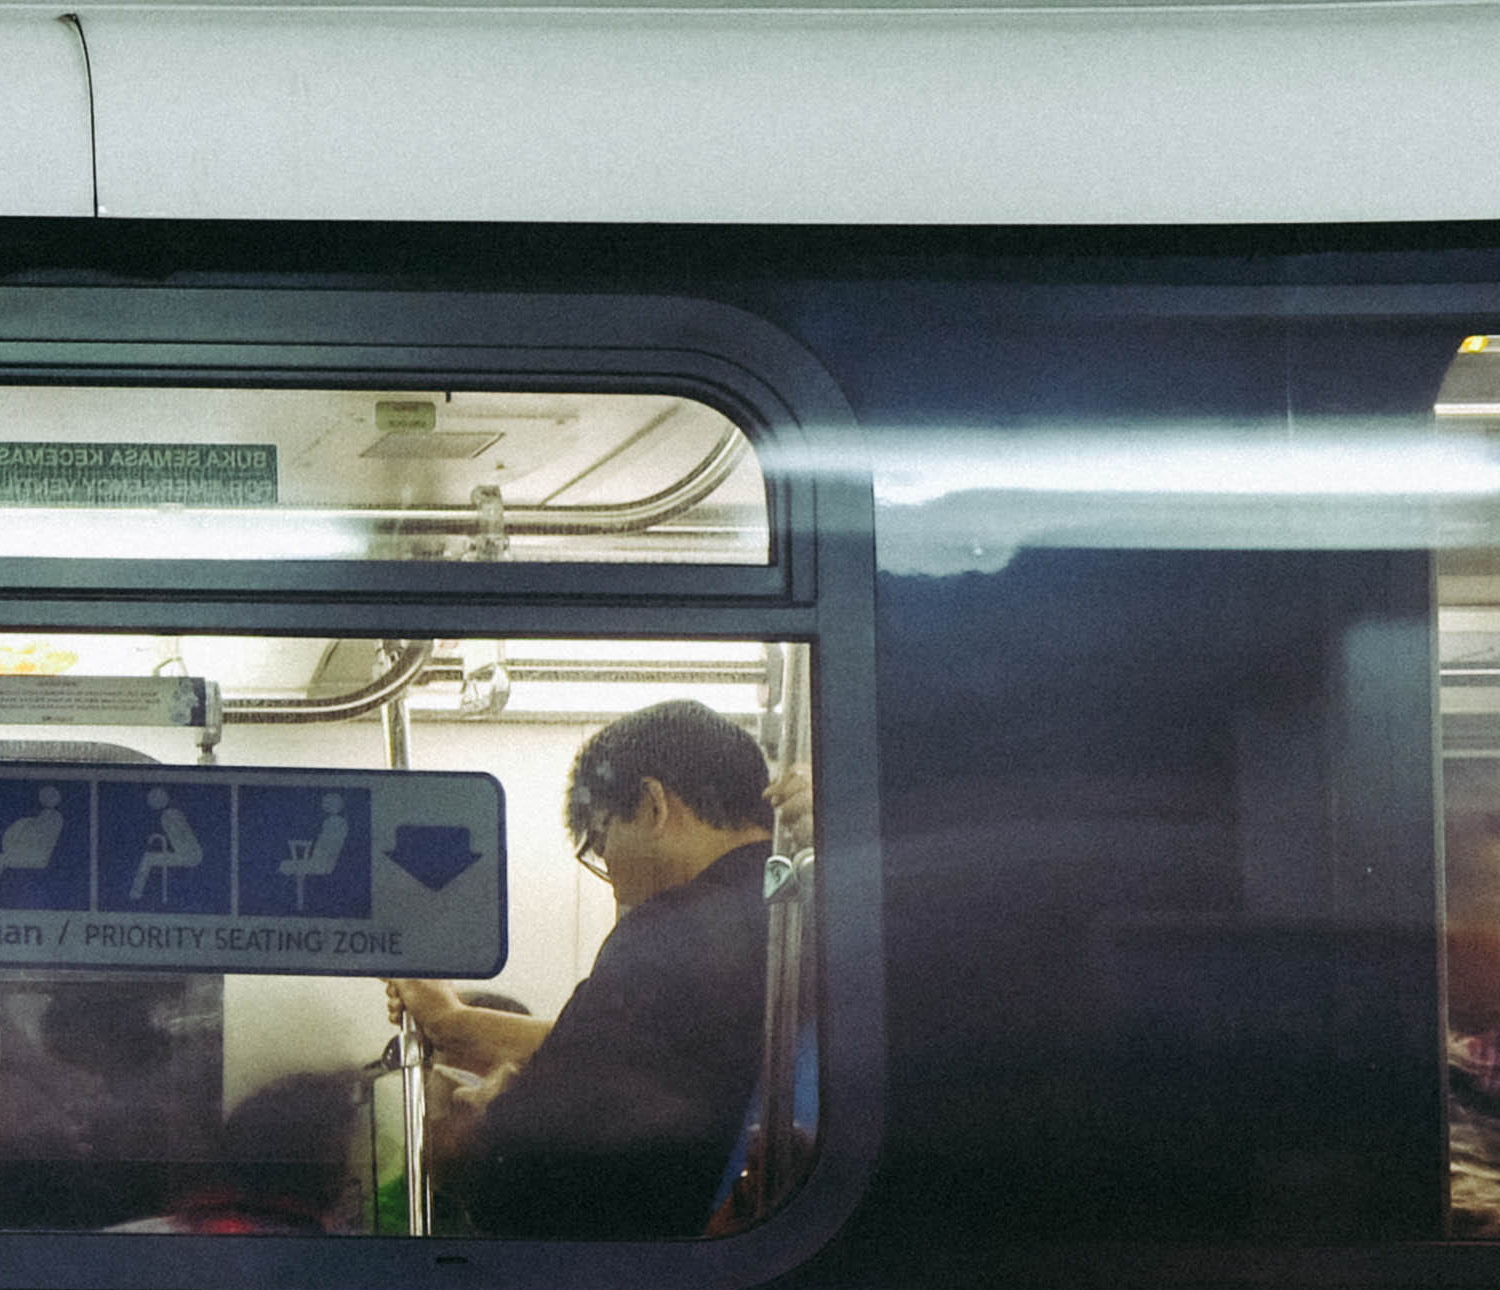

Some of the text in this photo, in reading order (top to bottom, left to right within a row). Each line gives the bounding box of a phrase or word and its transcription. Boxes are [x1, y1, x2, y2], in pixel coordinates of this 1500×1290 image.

[84, 923, 204, 951] PRIORITY
[214, 927, 324, 954] SEATING
[332, 931, 403, 956] ZONE
